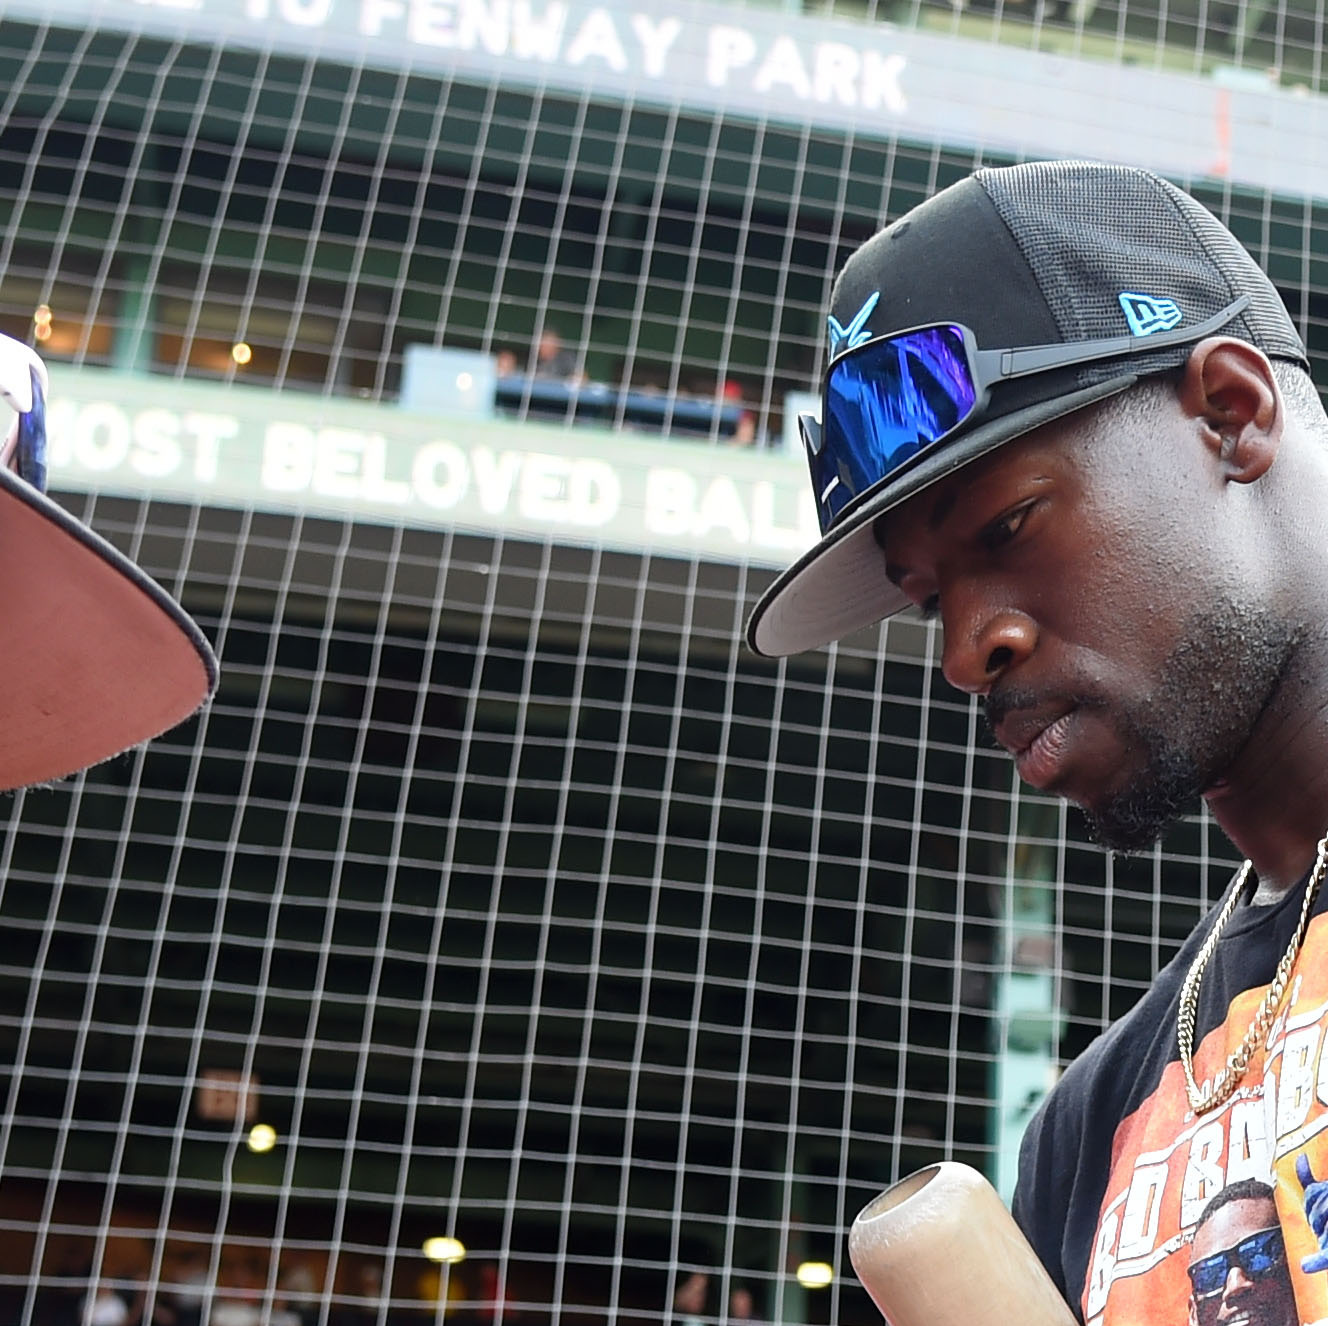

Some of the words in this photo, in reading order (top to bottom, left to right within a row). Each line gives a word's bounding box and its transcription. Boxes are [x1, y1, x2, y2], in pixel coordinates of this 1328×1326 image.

[358, 0, 682, 80] FENWAY
[705, 24, 909, 114] PARK
[261, 419, 621, 528] BELOVED
